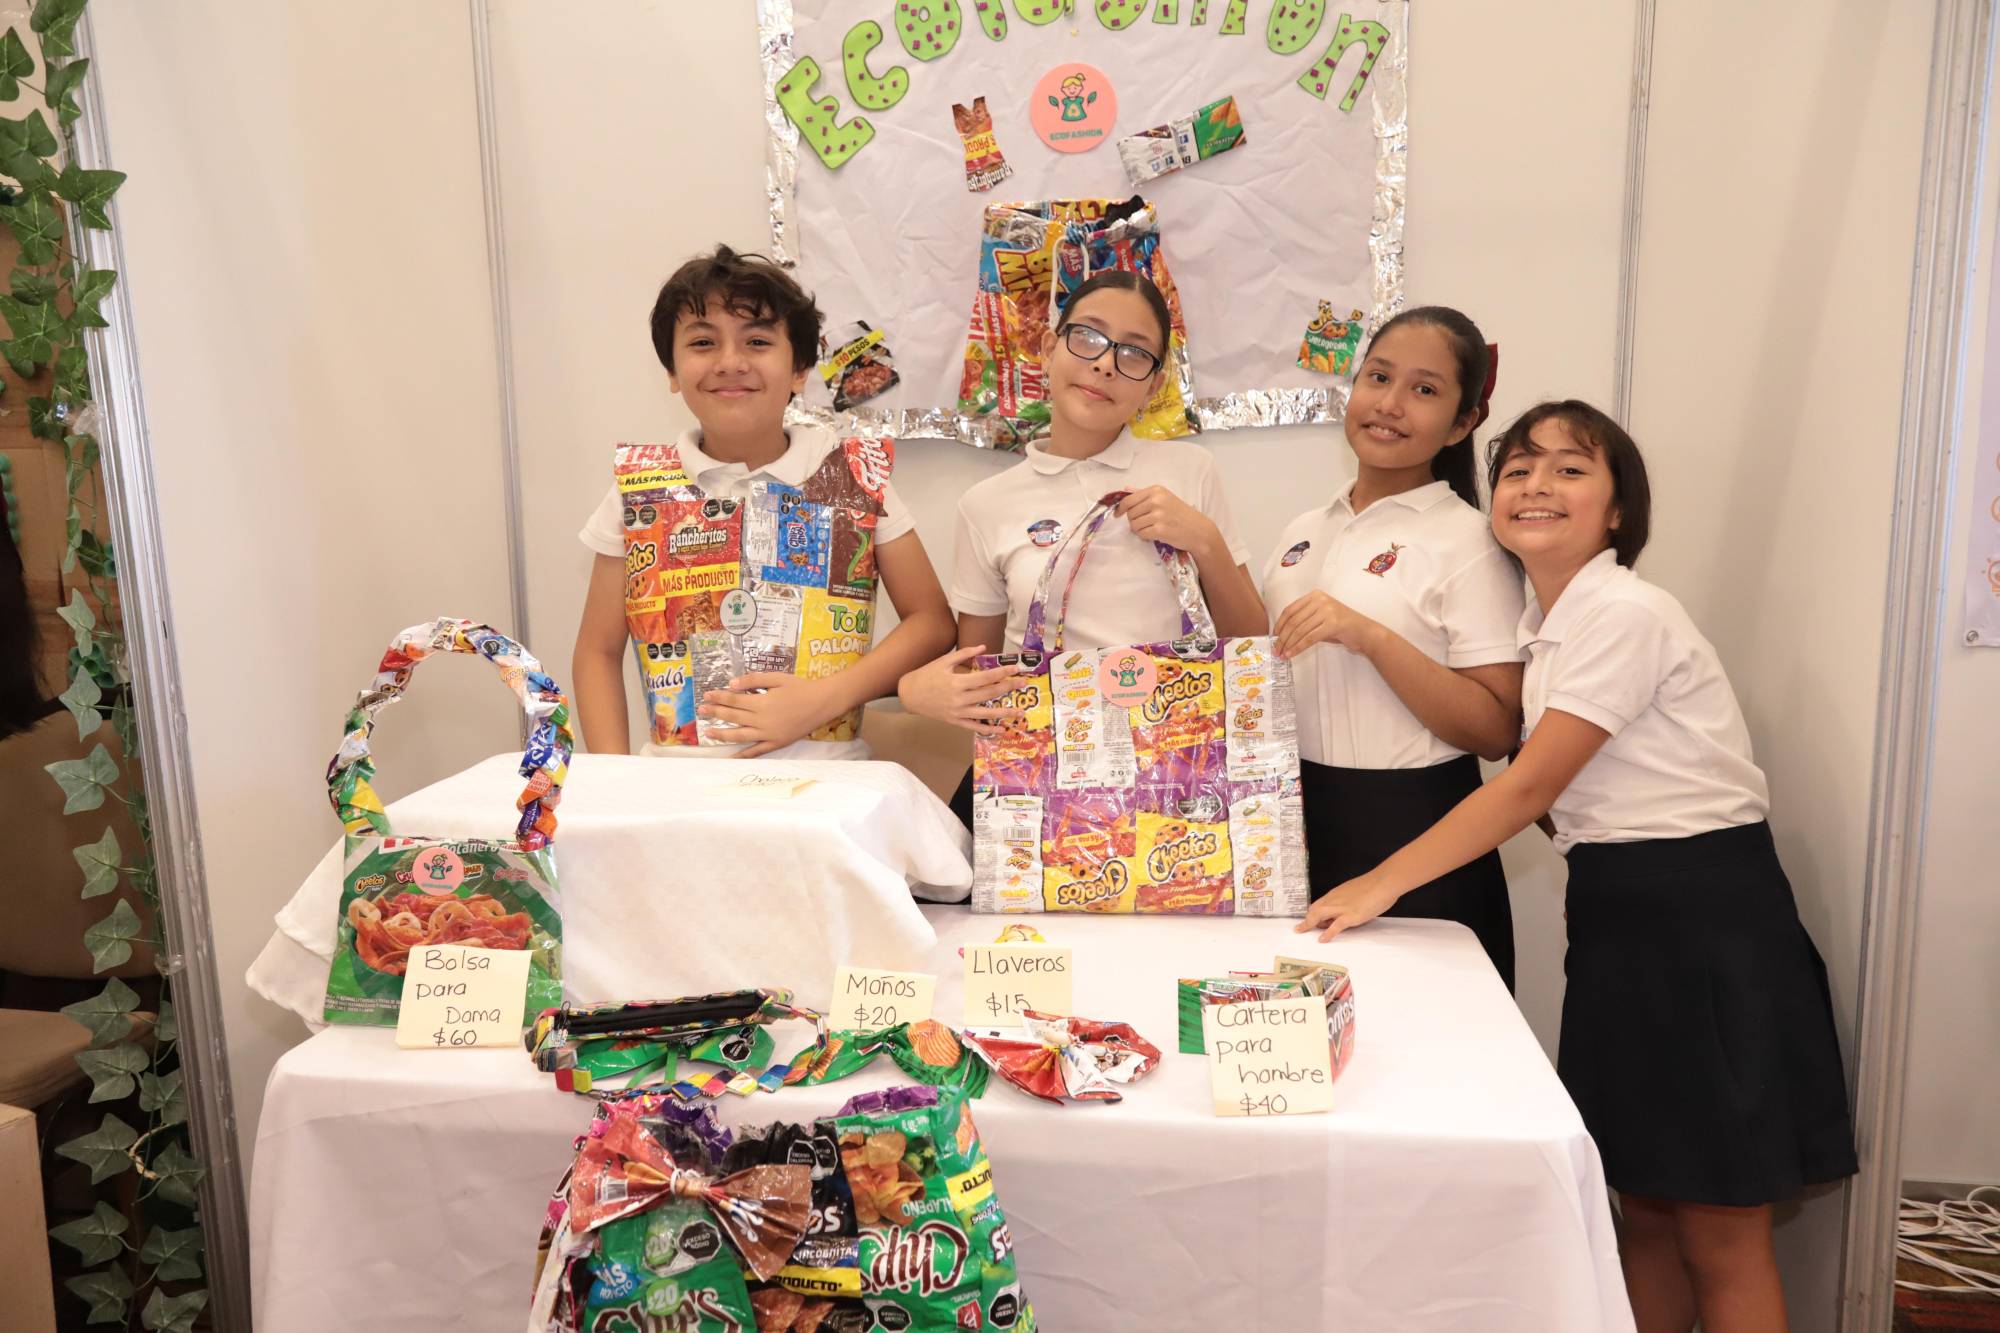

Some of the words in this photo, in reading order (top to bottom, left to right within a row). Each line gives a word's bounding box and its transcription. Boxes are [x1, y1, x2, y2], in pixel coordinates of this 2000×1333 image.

[669, 527, 728, 554] Rancheritos
[663, 573, 683, 593] MÁS
[685, 569, 735, 591] PRODUCTO
[1142, 670, 1212, 722] Cheetos
[1148, 831, 1217, 882] Cheetos
[1057, 860, 1128, 906] Cheetos
[425, 949, 490, 971] Bolsa
[973, 950, 1066, 975] Llaveros
[846, 973, 916, 998] Moños
[853, 1003, 897, 1029] $20
[985, 992, 1032, 1017] $15
[1217, 1003, 1307, 1028] Cartera
[432, 1027, 477, 1046] $60
[1216, 1037, 1272, 1064] para
[1238, 1062, 1325, 1084] hombre
[1239, 1093, 1288, 1116] $40
